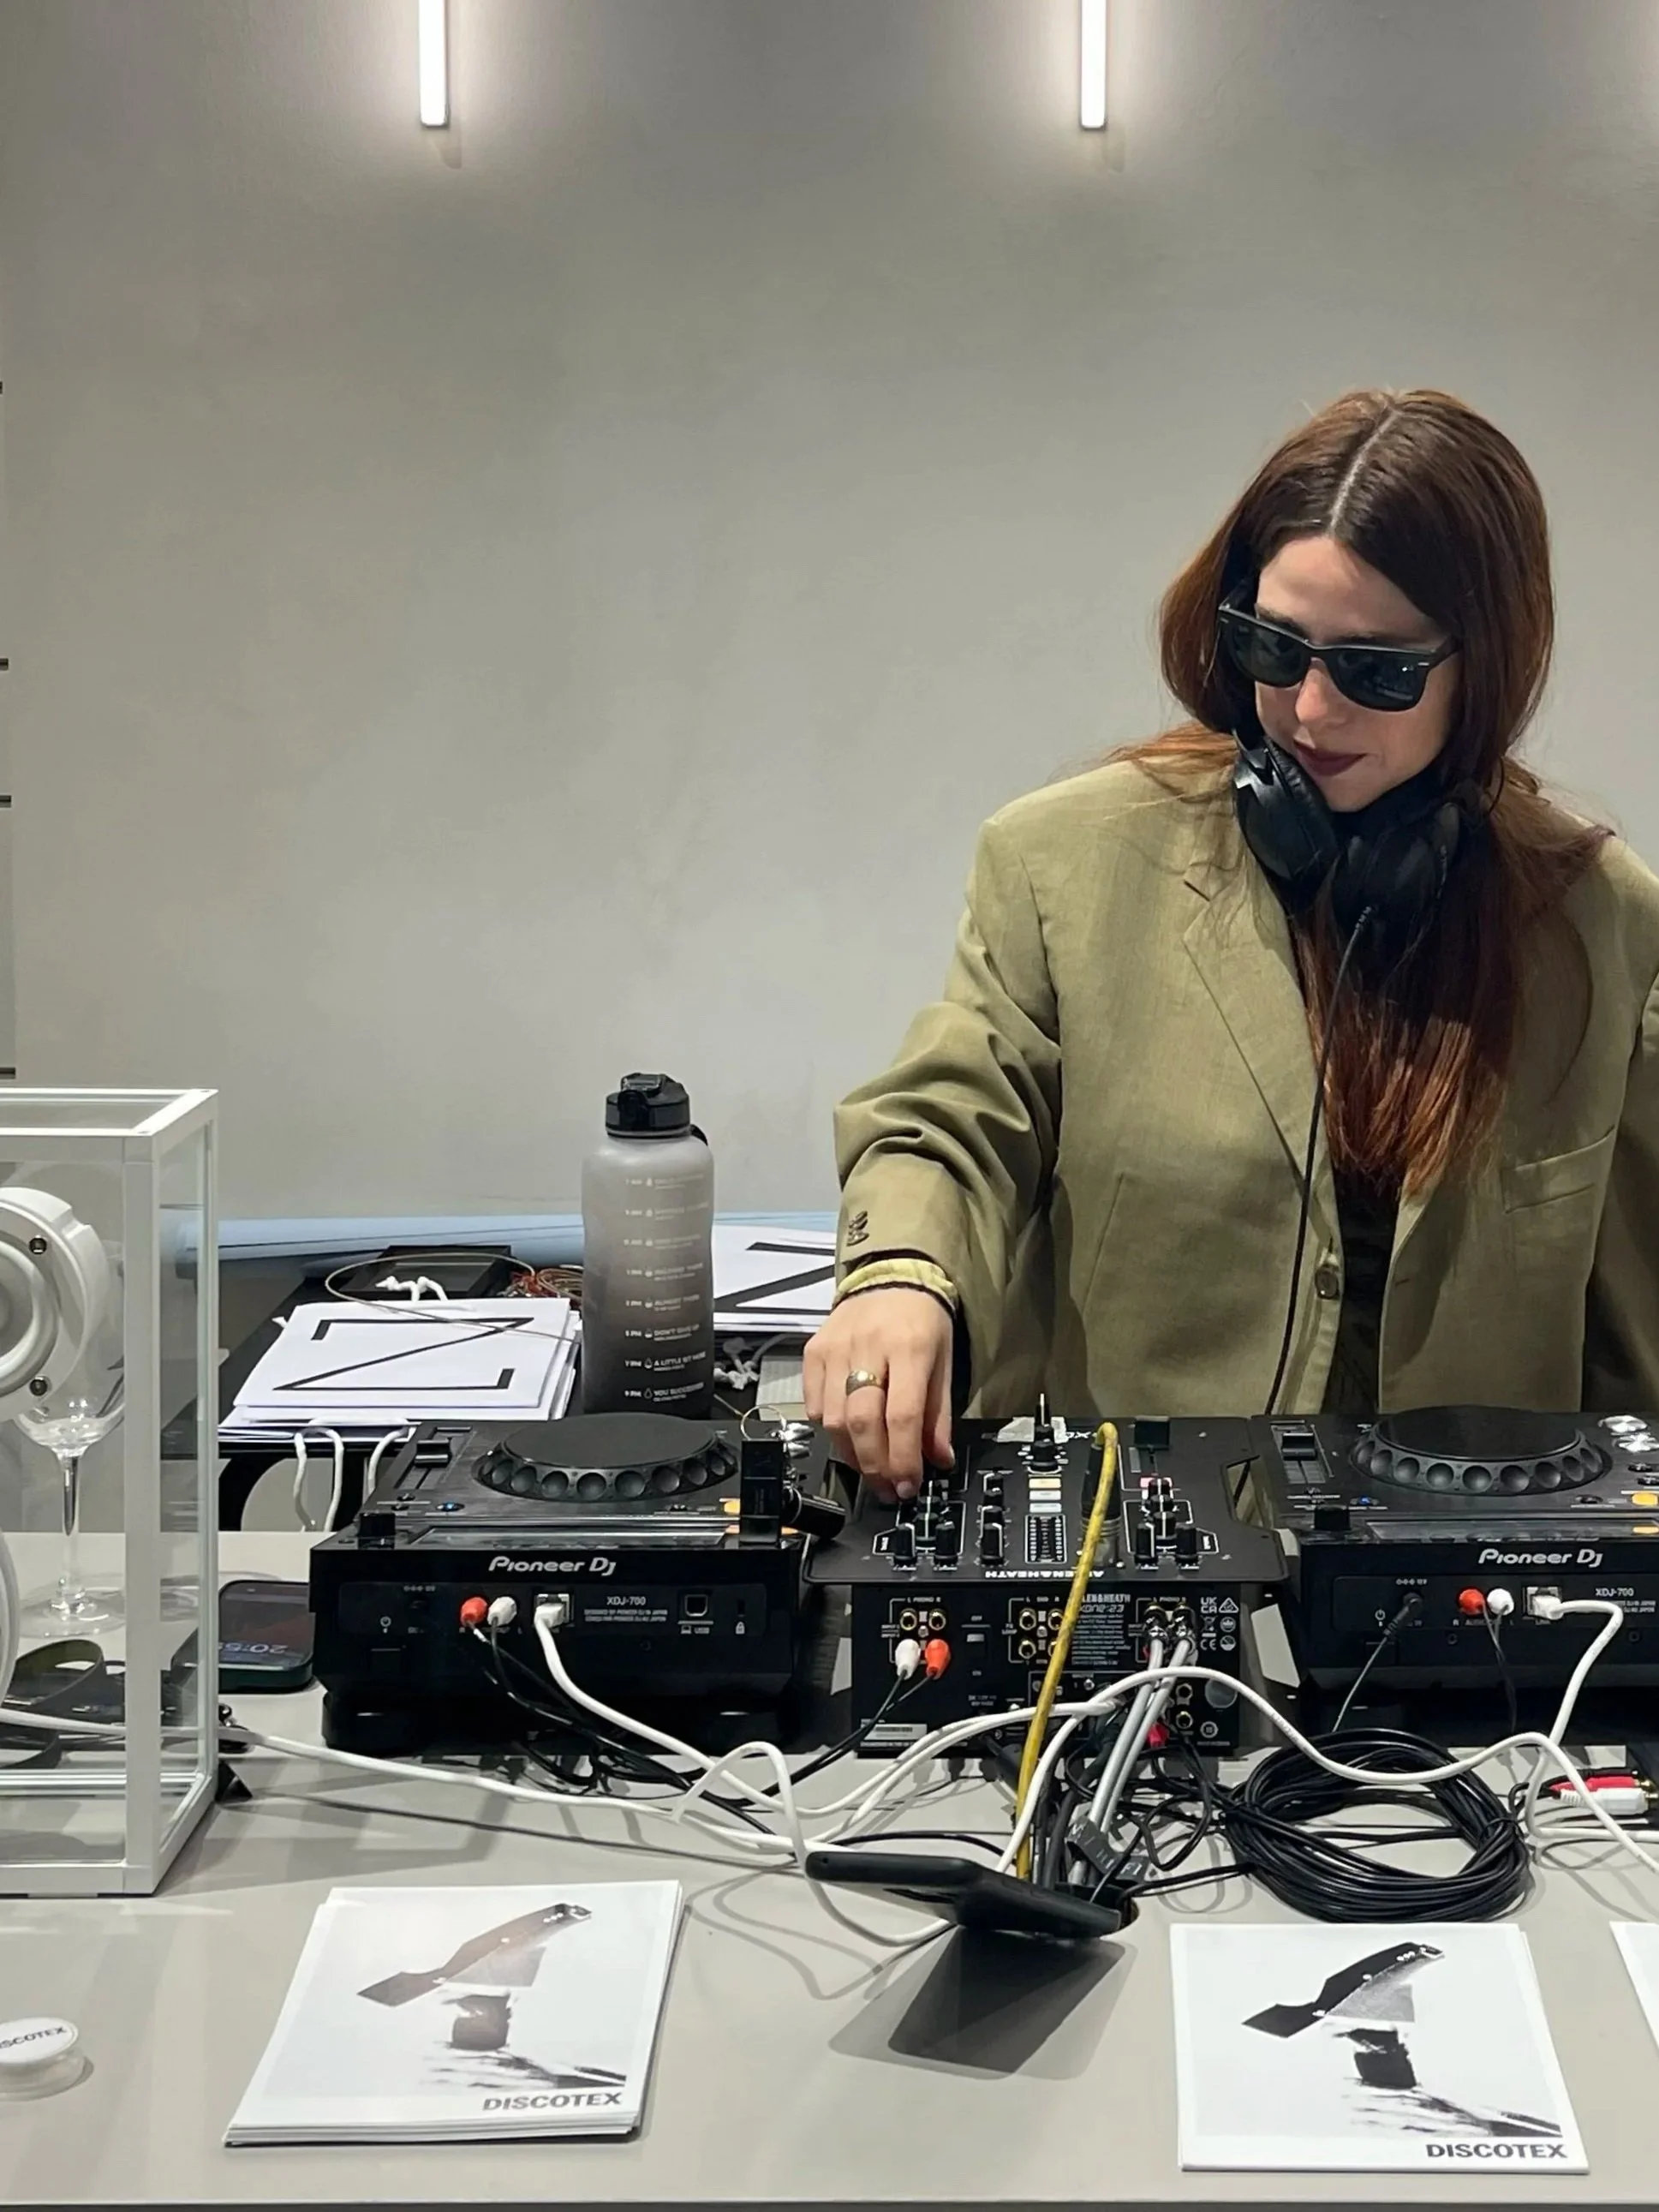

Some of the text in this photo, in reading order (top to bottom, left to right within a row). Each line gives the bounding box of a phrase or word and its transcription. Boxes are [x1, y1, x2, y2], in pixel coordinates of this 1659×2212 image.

[488, 1556, 586, 1572] Pioneer
[1478, 1548, 1572, 1564] Pioneer
[1595, 1587, 1634, 1597] XDJ-700
[606, 1596, 647, 1606] XDJ-700
[483, 2092, 623, 2111] DISCOTEX
[1425, 2143, 1568, 2159] DISCOTEX
